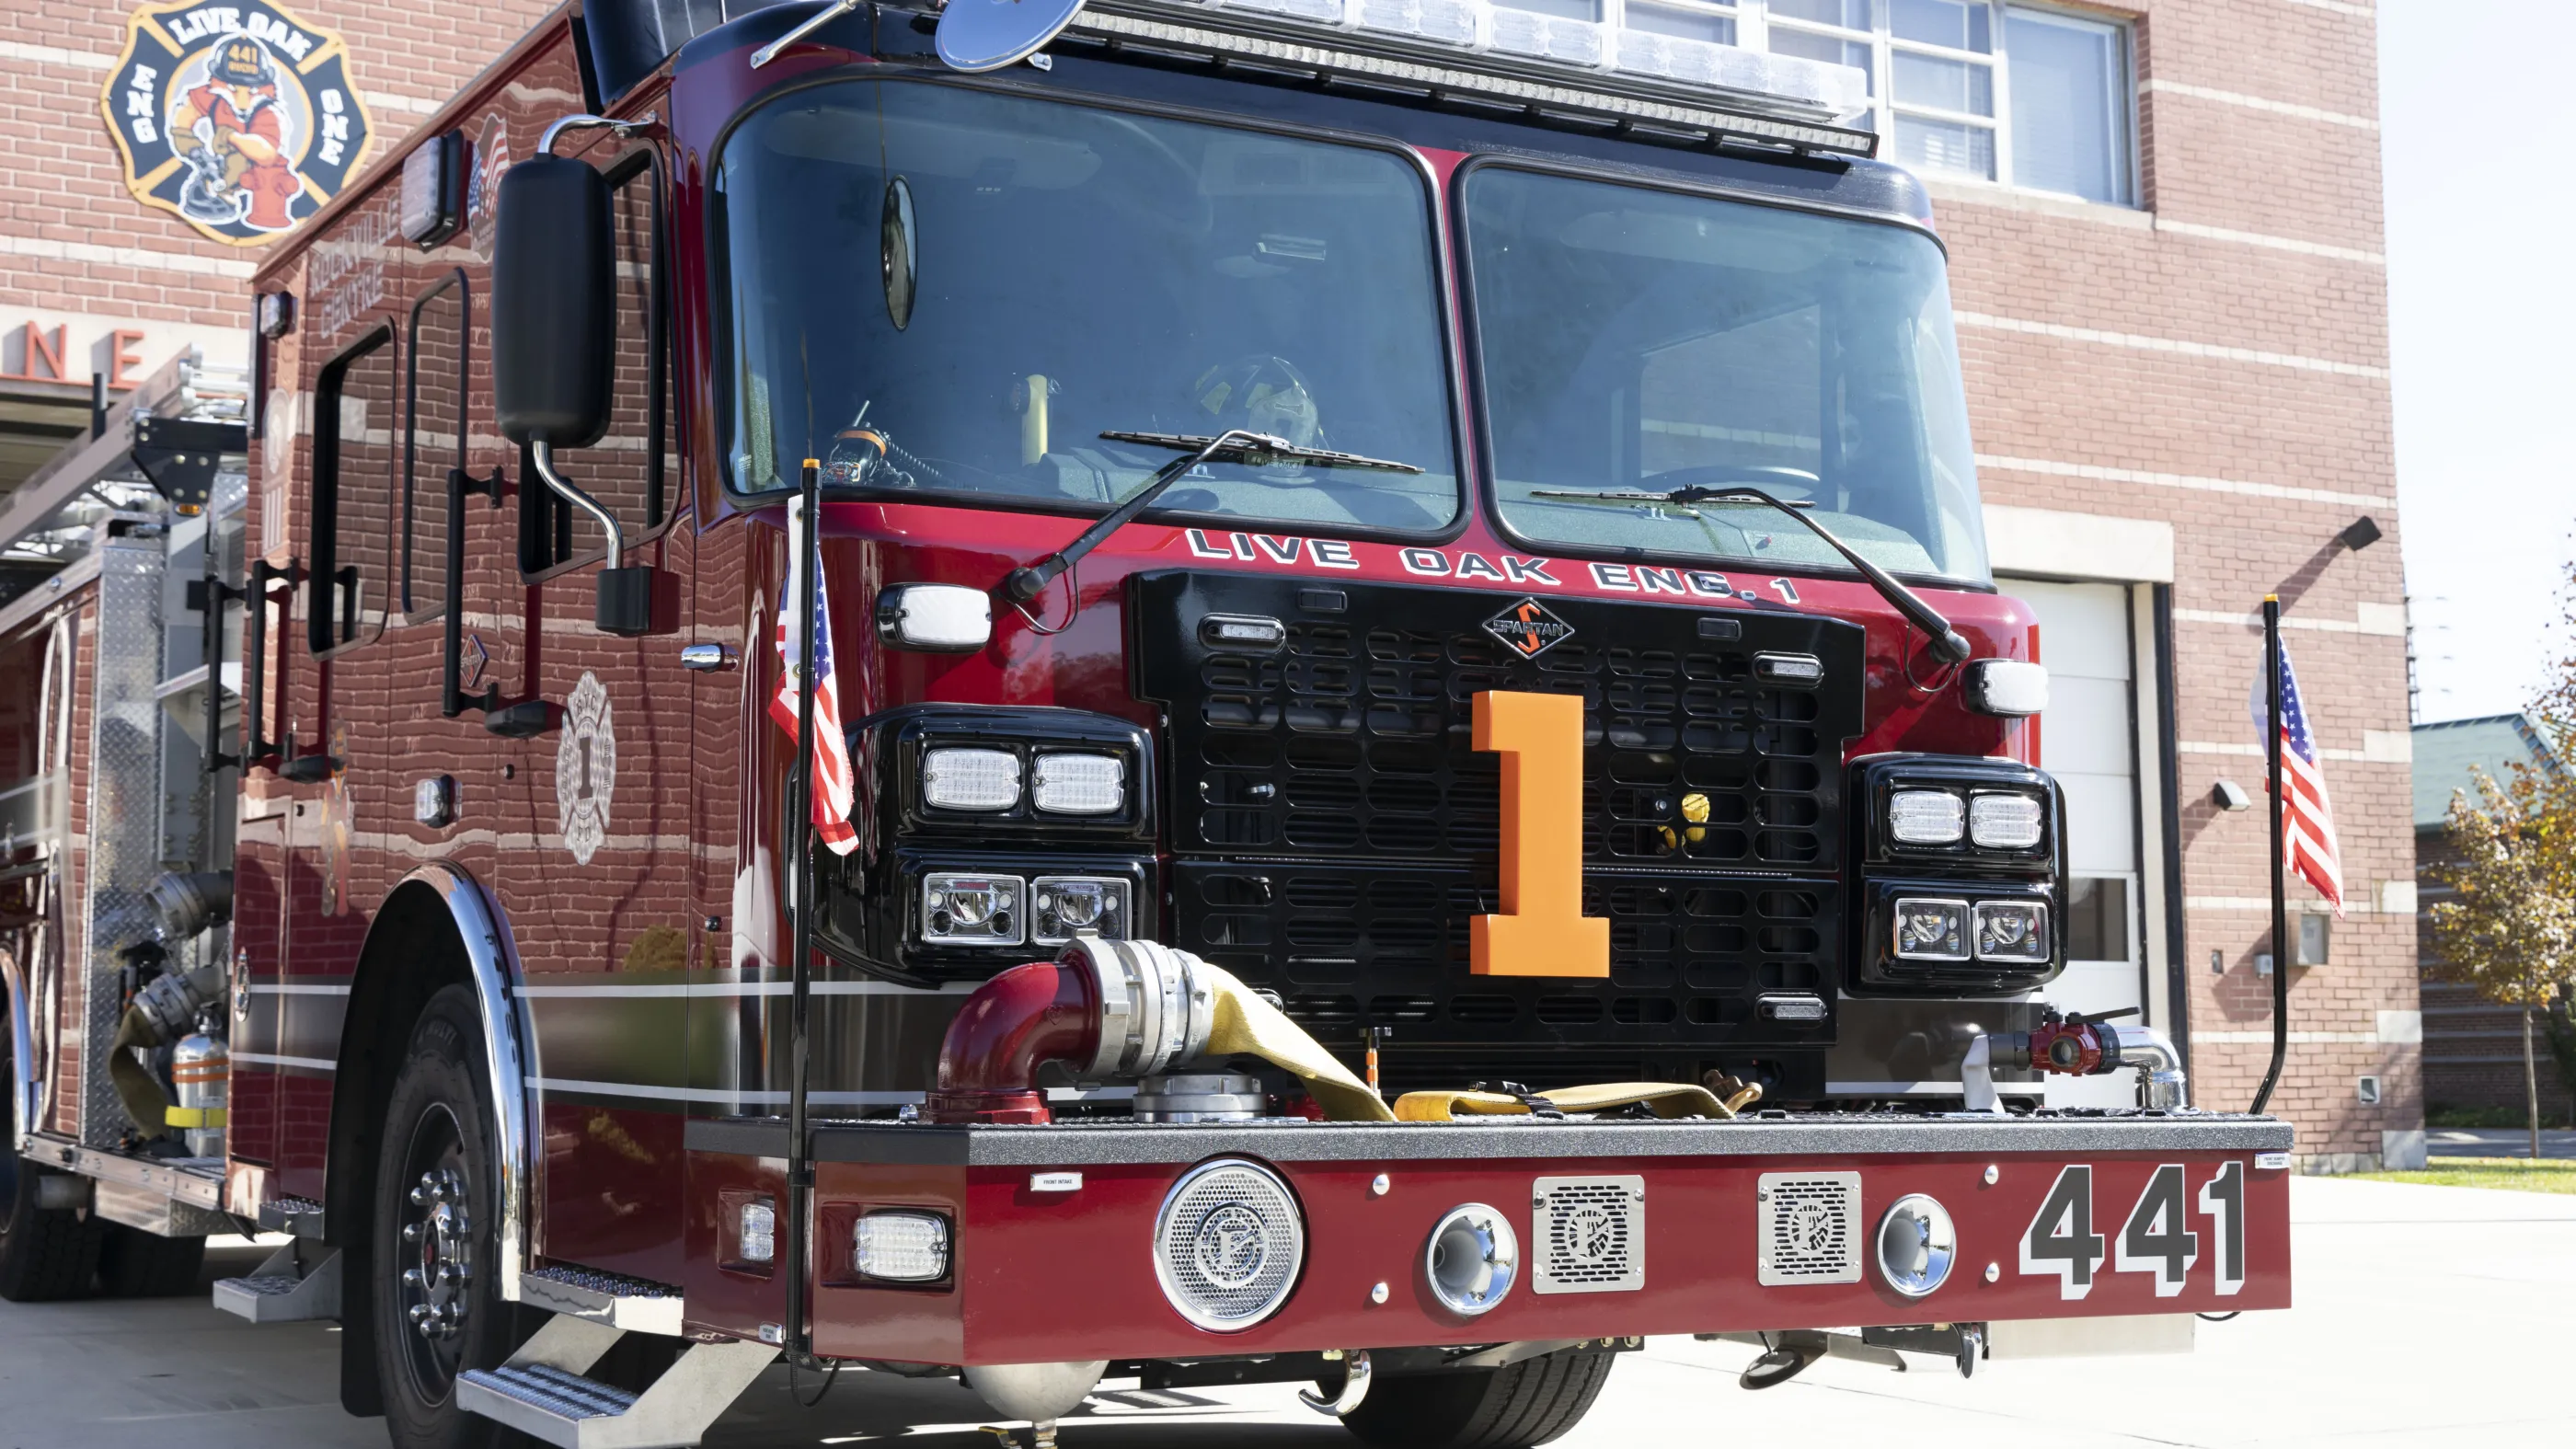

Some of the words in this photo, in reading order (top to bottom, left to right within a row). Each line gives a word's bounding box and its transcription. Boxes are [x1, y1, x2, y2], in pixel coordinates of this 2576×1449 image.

[168, 7, 239, 44] LIVE
[247, 12, 312, 61] OAK
[228, 44, 258, 64] 441
[127, 63, 158, 144] ENG
[318, 89, 349, 166] ONE
[321, 260, 384, 339] CENTRE
[1185, 528, 1360, 569] LIVE
[1398, 547, 1562, 586] OAK
[1493, 619, 1563, 637] SPARTAN
[578, 736, 593, 800] 1
[1470, 690, 1610, 977] 1
[2018, 1161, 2245, 1301] 441
